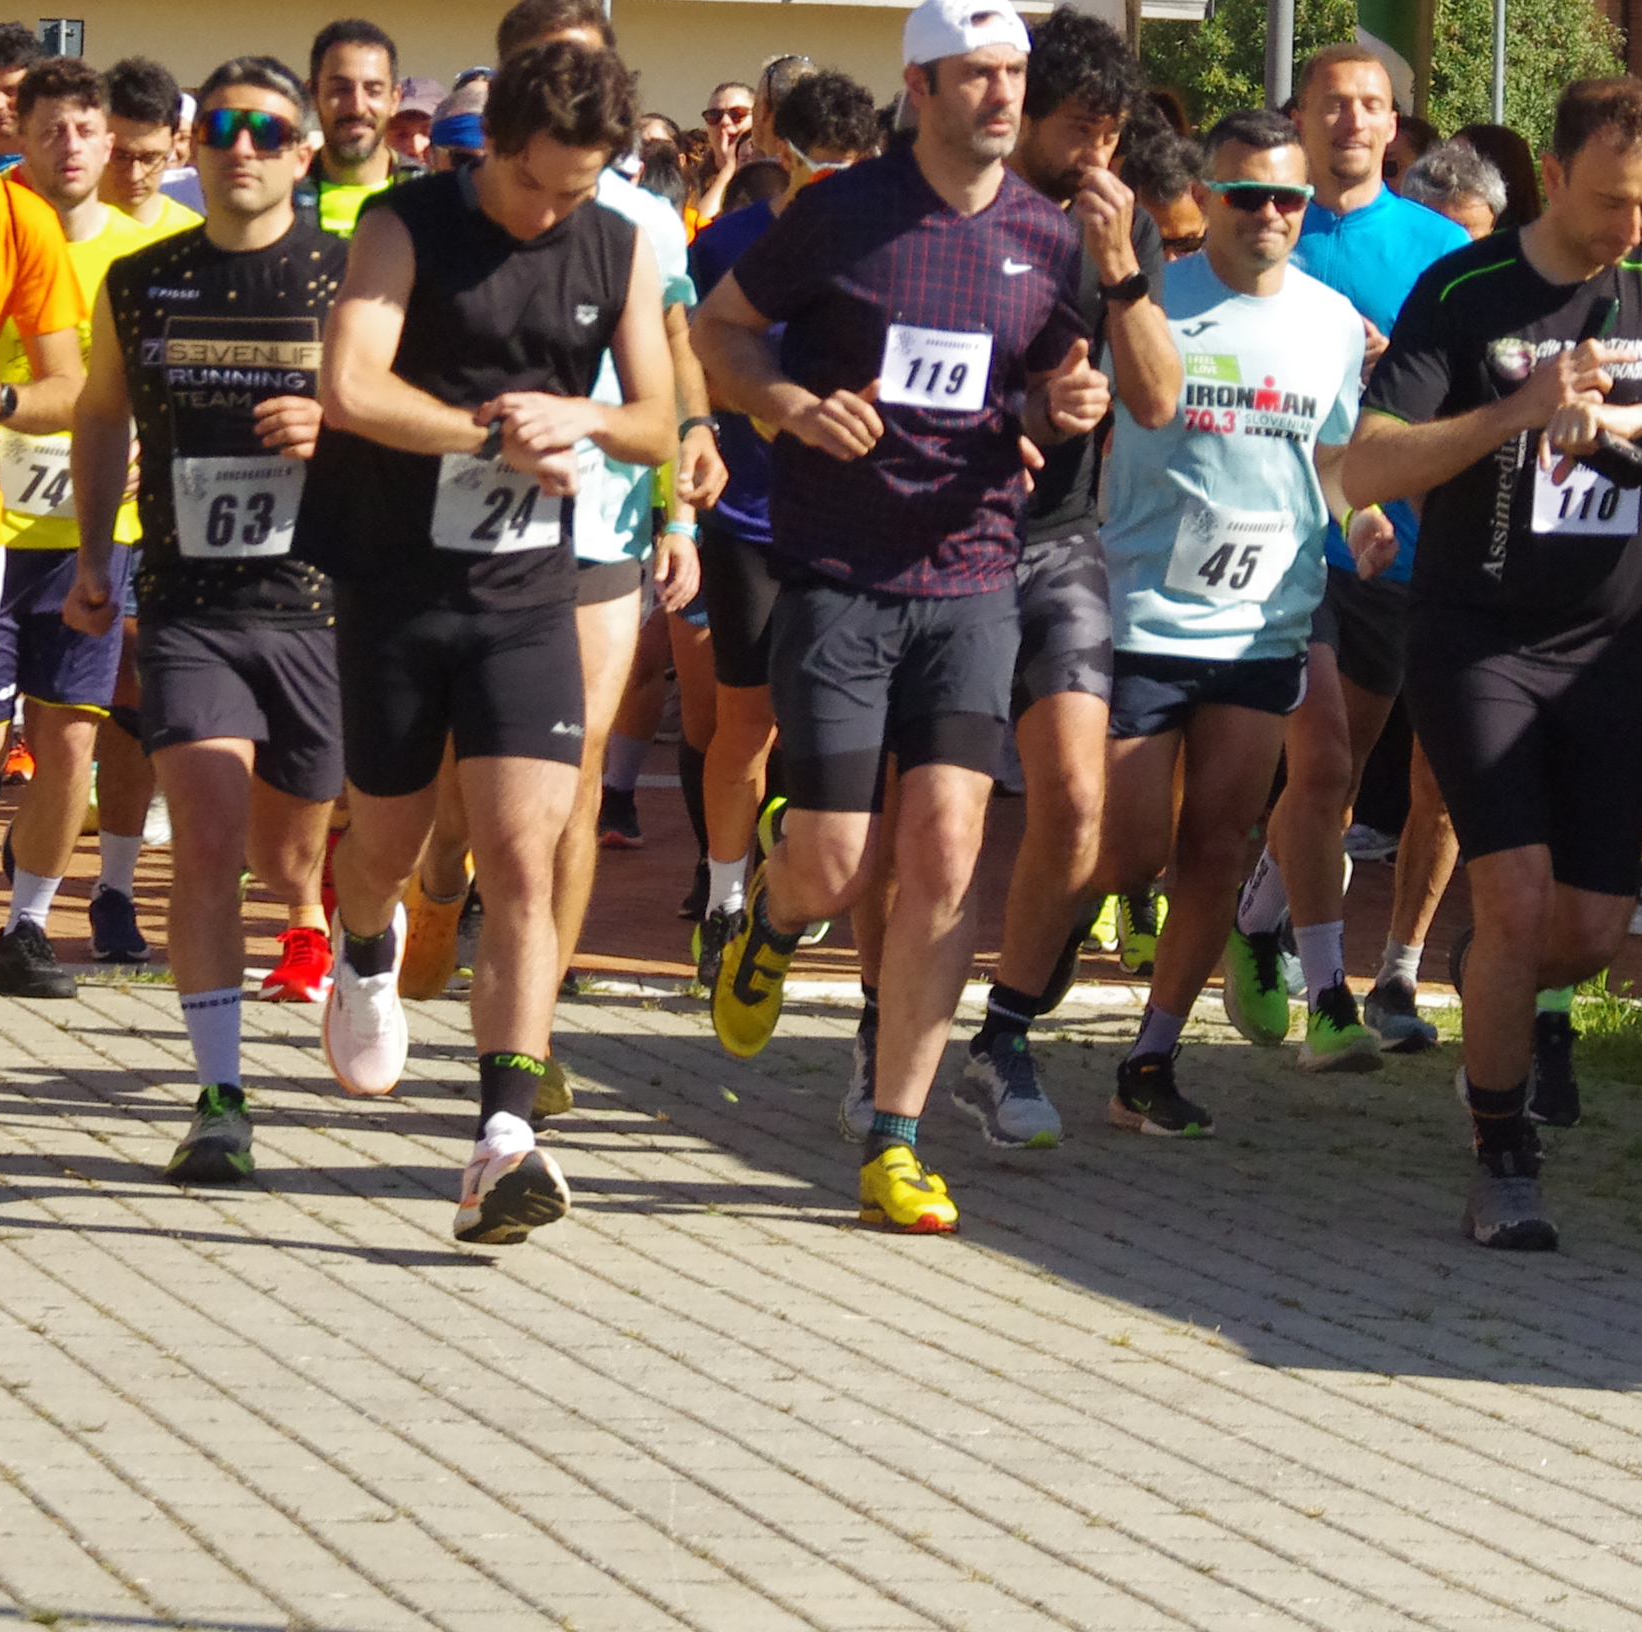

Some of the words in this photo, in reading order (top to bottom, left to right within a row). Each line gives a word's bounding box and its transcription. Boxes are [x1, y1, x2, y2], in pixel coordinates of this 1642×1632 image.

[168, 343, 323, 365] SEVENLIF
[168, 368, 307, 389] RUNNING
[904, 357, 969, 396] 119
[173, 391, 252, 408] TEAM
[1186, 376, 1317, 418] IRONMAN
[1185, 407, 1237, 434] 70.3
[17, 463, 71, 509] 74
[1559, 485, 1620, 521] 110
[206, 492, 276, 547] 63
[469, 485, 542, 541] 24
[1482, 434, 1518, 583] Assimedi
[1198, 542, 1264, 590] 45
